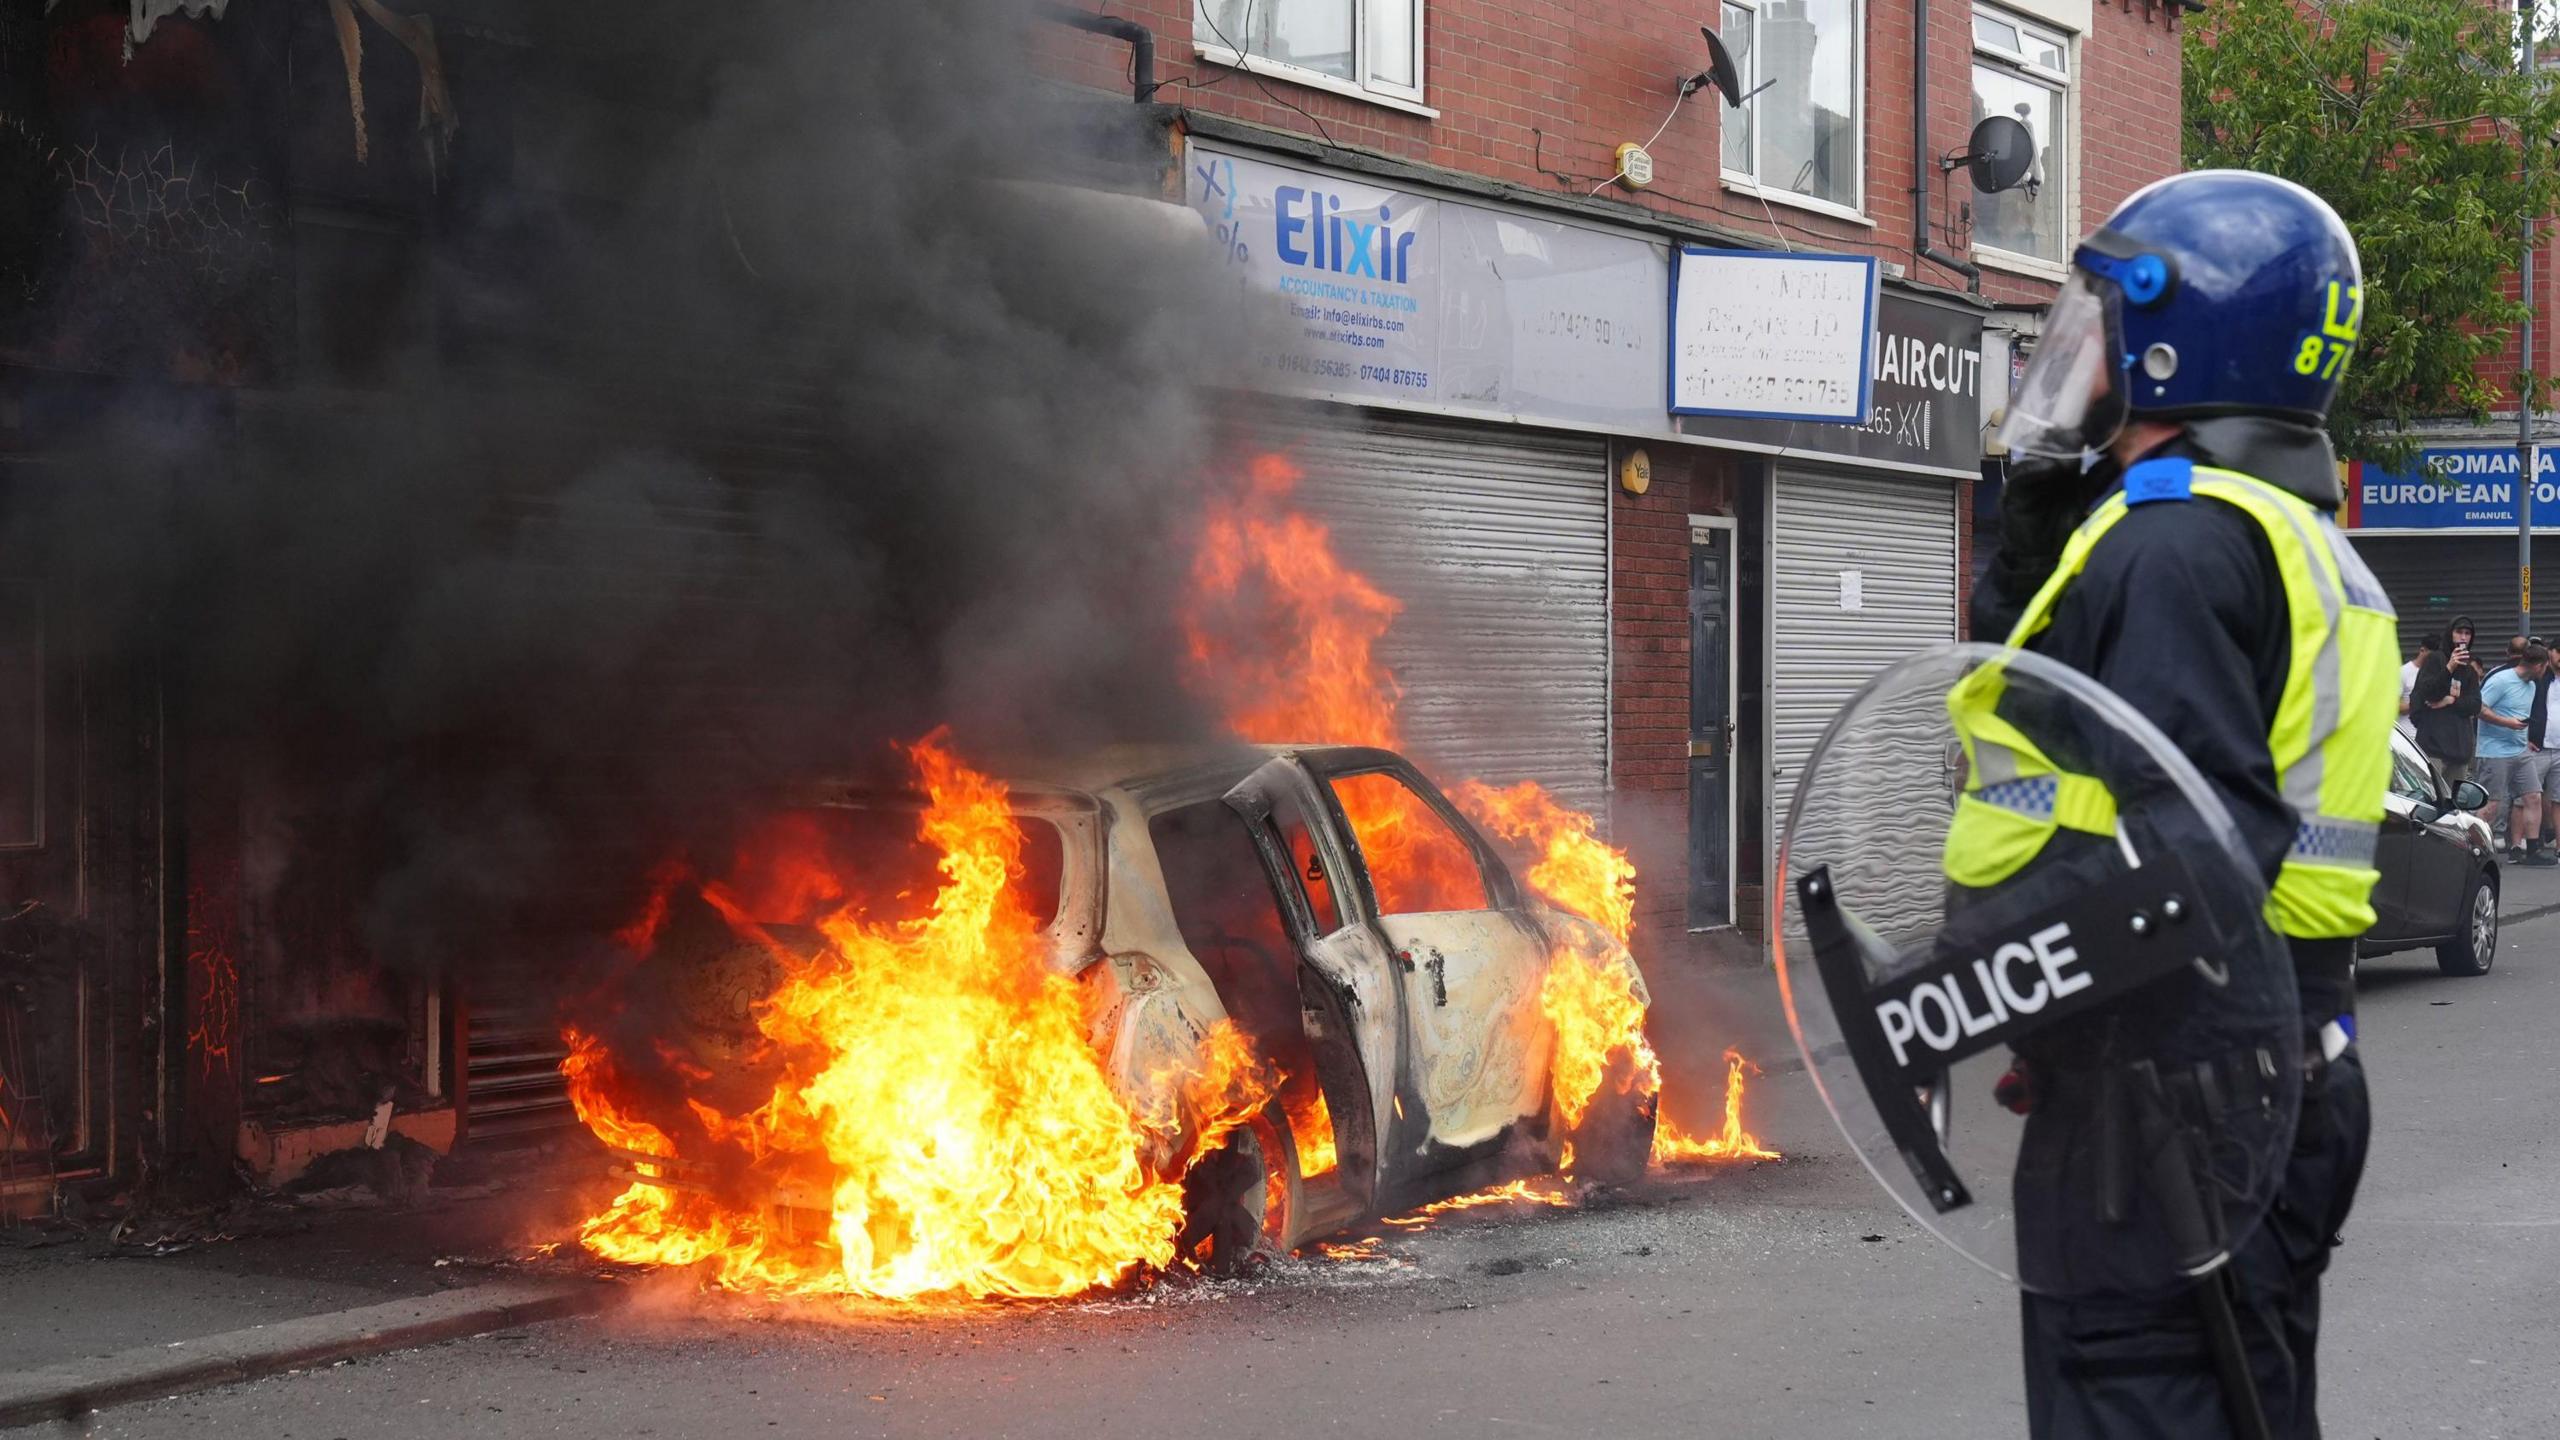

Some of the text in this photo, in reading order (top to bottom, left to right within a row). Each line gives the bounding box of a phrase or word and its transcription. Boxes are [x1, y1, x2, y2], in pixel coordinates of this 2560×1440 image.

[1274, 184, 1416, 284] Elixir
[1279, 275, 1417, 313] ACCOUNTANCY & TAXATION
[1304, 326, 1385, 348] www.elixirbs.com
[1360, 364, 1391, 383] 07404
[1393, 367, 1428, 388] 876755
[2427, 453, 2556, 475] ROMANA
[2362, 483, 2511, 504] EUROPEAN
[2465, 511, 2513, 520] EMANUEL
[1875, 921, 2094, 1067] POLICE
